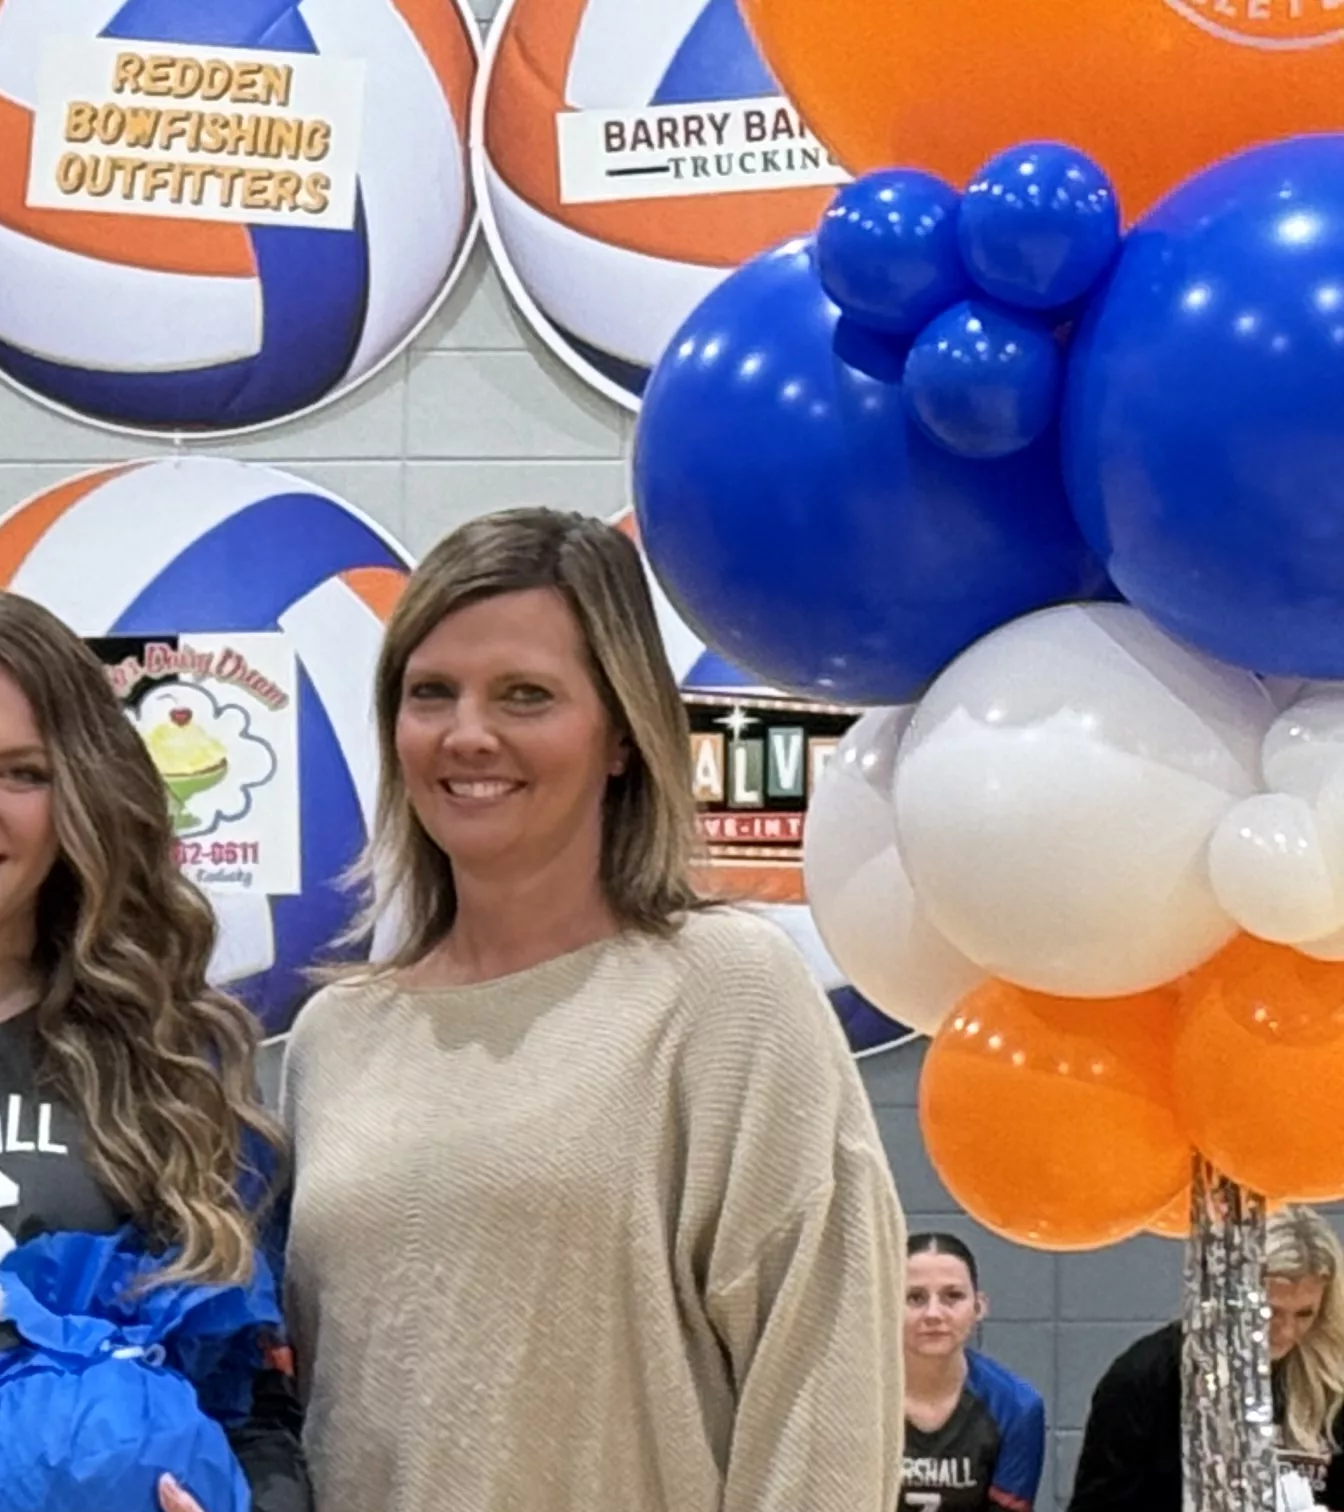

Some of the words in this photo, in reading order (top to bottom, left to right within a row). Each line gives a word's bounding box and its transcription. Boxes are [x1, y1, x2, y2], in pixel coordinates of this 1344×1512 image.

[113, 51, 293, 106] REDDEN
[65, 100, 332, 162] BOWFISHING
[603, 111, 732, 154] BARRY
[55, 151, 332, 214] OUTFITTERS
